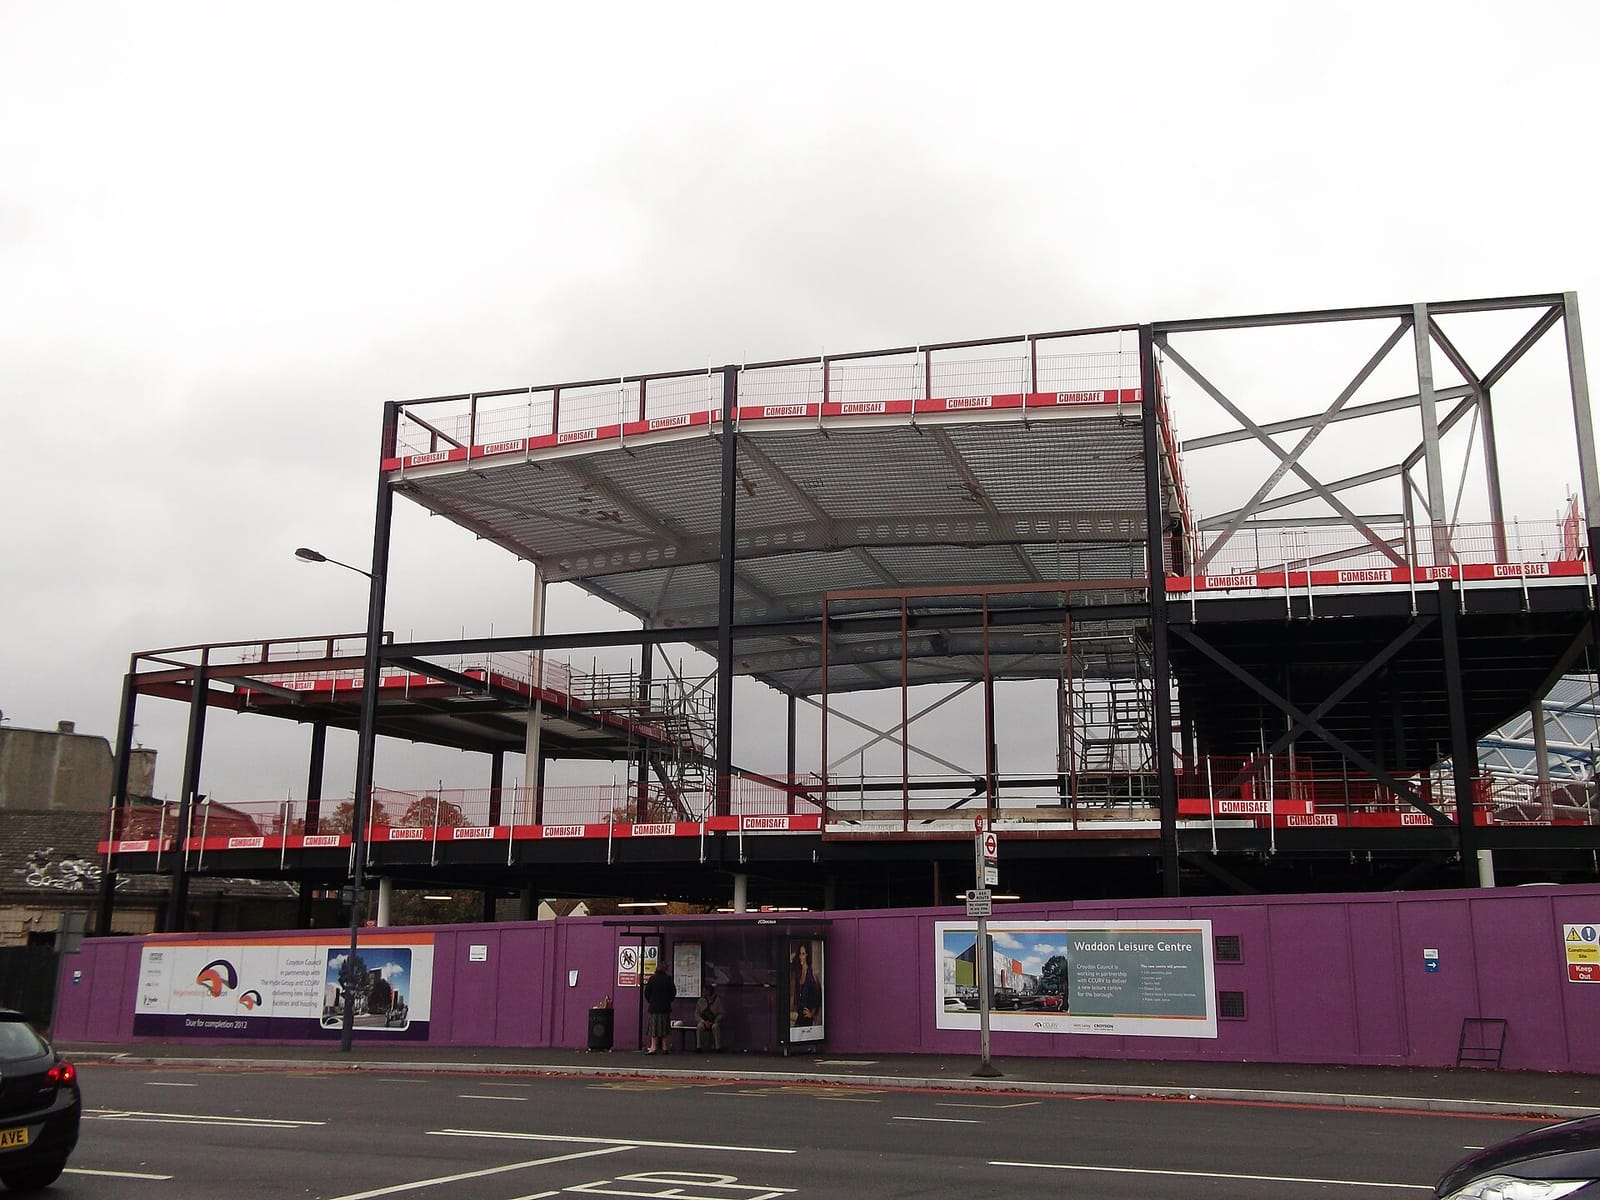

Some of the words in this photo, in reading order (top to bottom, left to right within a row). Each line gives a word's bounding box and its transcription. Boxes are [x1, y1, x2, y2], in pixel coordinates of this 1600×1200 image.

[1059, 392, 1100, 402] COMBISAFE
[948, 398, 988, 408] COMBISAFE
[766, 406, 802, 416] COMBISAFE
[843, 404, 882, 414] COMBISAFE
[651, 416, 687, 429] COMBISAFE
[559, 430, 594, 443] COMBISAFE
[485, 440, 519, 454] COMBISAFE
[412, 452, 446, 464] COMBISAFE
[1496, 562, 1545, 576] COMBSAFE
[1208, 576, 1252, 587] COMBISAFE
[1341, 570, 1388, 582] COMBISAFE
[1221, 802, 1268, 812] COMBISAFE
[746, 818, 784, 828] COMBISAFE
[1290, 815, 1334, 826] COMBISAFE
[455, 828, 490, 838] COMBISAFE
[544, 826, 582, 836] COMBISAFE
[634, 824, 672, 834] COMBISAFE
[1074, 941, 1115, 952] Waddon
[1118, 942, 1154, 952] Leisure
[1157, 942, 1192, 952] Centre
[0, 1130, 24, 1146] AVE
